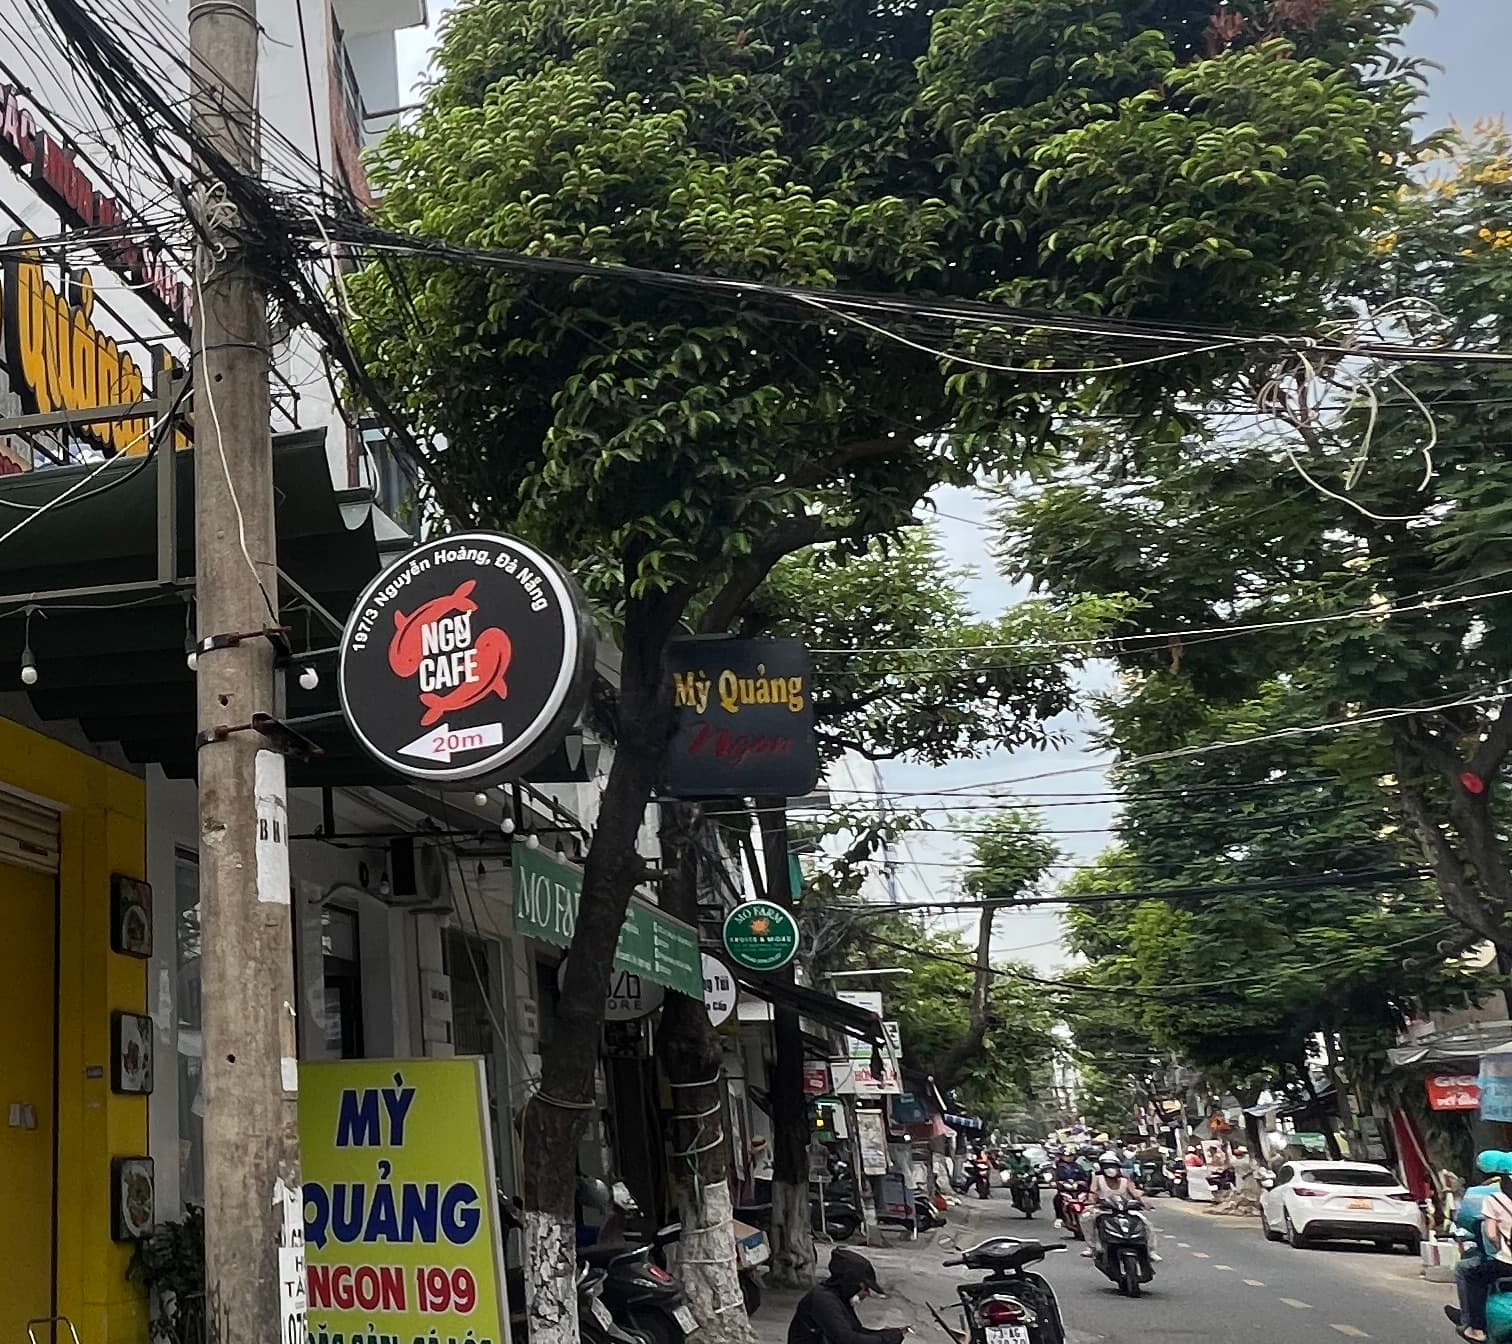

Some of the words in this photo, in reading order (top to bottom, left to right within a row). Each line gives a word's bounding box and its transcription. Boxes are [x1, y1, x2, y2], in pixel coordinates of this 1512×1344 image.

[352, 608, 379, 652] 197/3
[374, 559, 431, 607] Nguyễn
[494, 552, 519, 575] Đà
[419, 648, 480, 693] CAFE
[718, 663, 805, 713] Quảng
[432, 732, 483, 754] 20m
[518, 866, 551, 927] MO
[753, 906, 784, 924] FARM
[336, 1072, 416, 1147] MỲ
[303, 1160, 481, 1251] QUẢNG
[307, 1265, 406, 1311] NGON
[416, 1267, 477, 1314] 199
